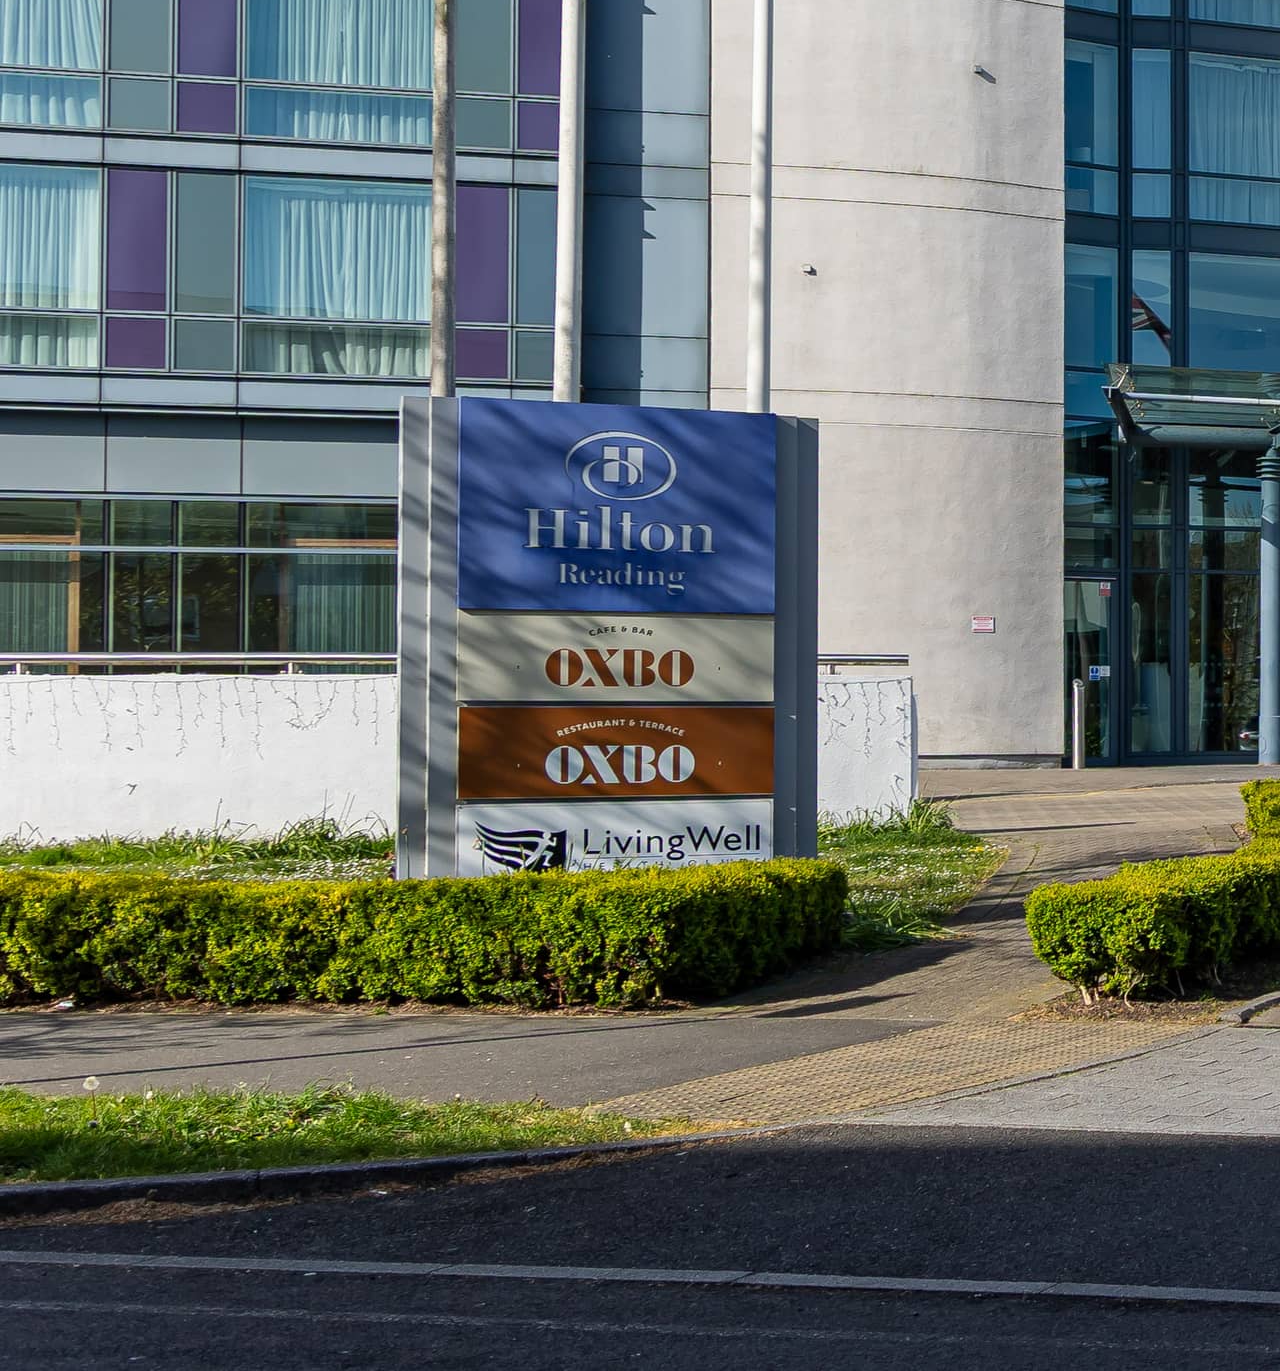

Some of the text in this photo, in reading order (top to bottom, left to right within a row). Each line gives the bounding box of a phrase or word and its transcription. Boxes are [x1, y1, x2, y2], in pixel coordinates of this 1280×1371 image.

[524, 505, 716, 553] Hilton
[559, 561, 686, 596] Reading
[588, 625, 617, 637] CAFE
[632, 627, 654, 637] BAR
[545, 648, 695, 687] OXBO
[556, 718, 686, 737] RESTAURANT & TERRACE
[545, 744, 696, 785] OXBO
[583, 824, 761, 861] LivingWell
